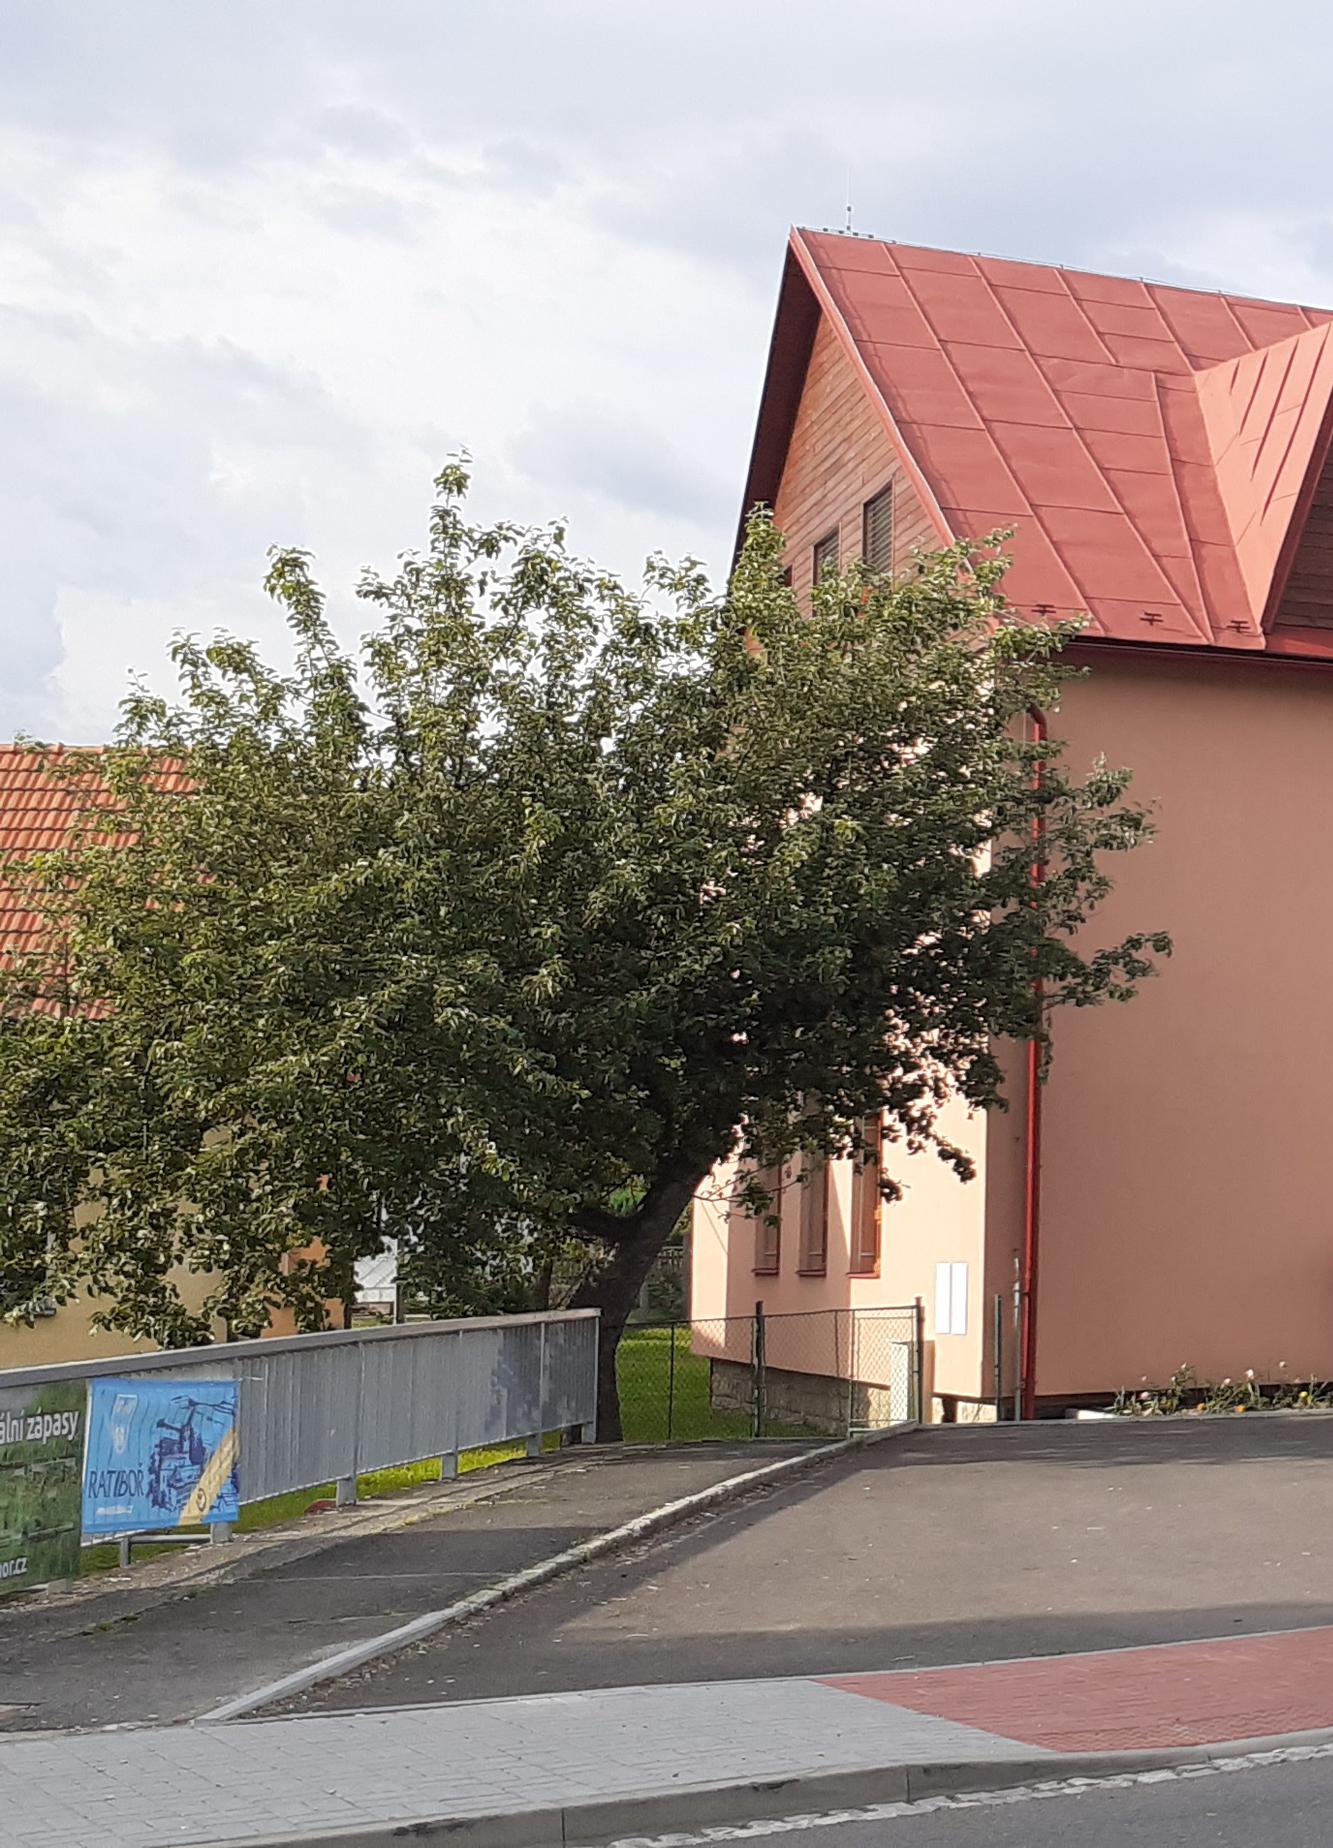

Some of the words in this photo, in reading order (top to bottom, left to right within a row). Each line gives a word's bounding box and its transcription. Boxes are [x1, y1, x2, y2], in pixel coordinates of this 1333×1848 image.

[26, 1405, 80, 1445] zápasy
[88, 1462, 146, 1499] RATIBOŘ
[0, 1557, 28, 1579] or.cz
